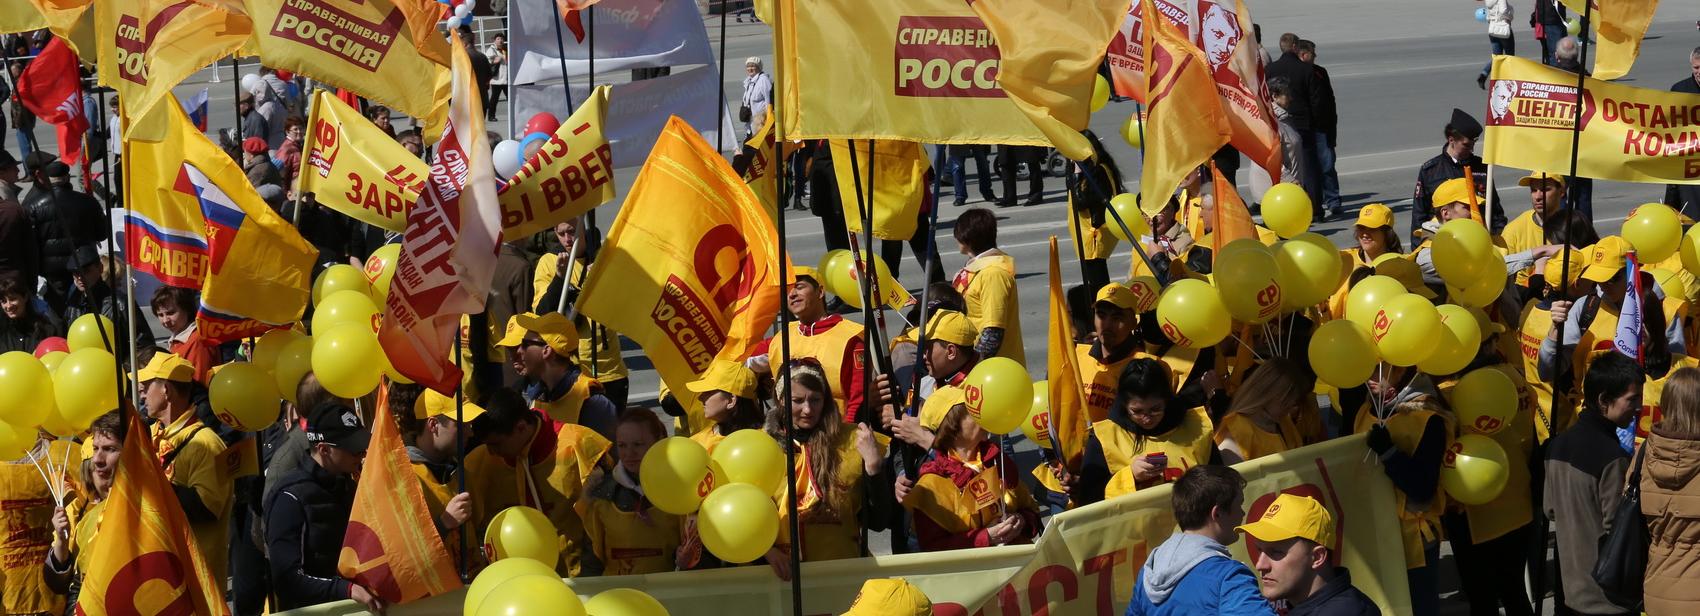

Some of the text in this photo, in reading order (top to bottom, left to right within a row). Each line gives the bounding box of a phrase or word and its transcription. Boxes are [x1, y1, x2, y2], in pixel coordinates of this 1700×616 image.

[287, 0, 390, 45] СПРАВЕДЛИВАЯ
[276, 13, 382, 68] РОССИЯ
[899, 58, 1001, 90] РОСС
[1520, 89, 1549, 99] РОССИЯ
[1521, 82, 1578, 94] СПРАВЕДЛИВАЯ
[1257, 285, 1277, 306] СР
[1475, 415, 1500, 431] СР
[697, 471, 714, 498] СР
